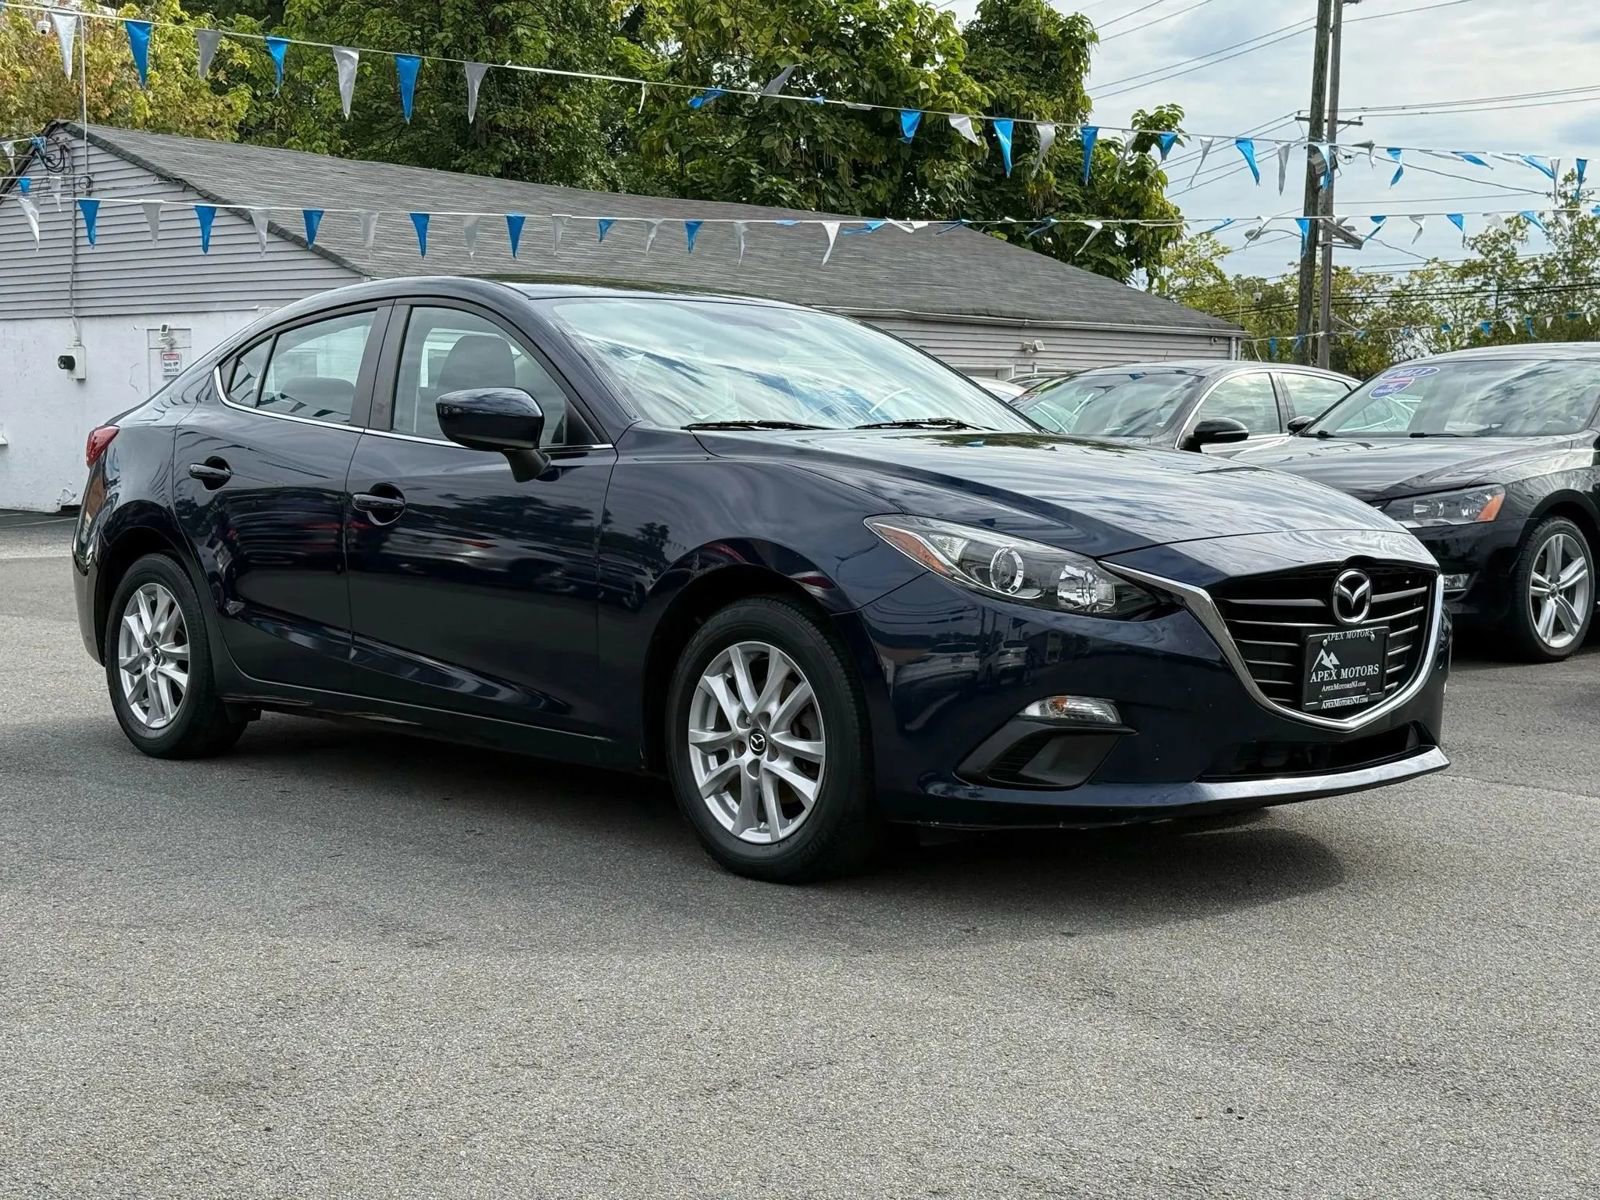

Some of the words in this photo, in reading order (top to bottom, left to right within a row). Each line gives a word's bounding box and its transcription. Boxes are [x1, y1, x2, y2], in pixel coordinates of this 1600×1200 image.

[1327, 632, 1344, 641] APEX
[1346, 630, 1374, 640] MOTORS
[1310, 669, 1337, 683] APEX
[1340, 663, 1379, 680] MOTORS
